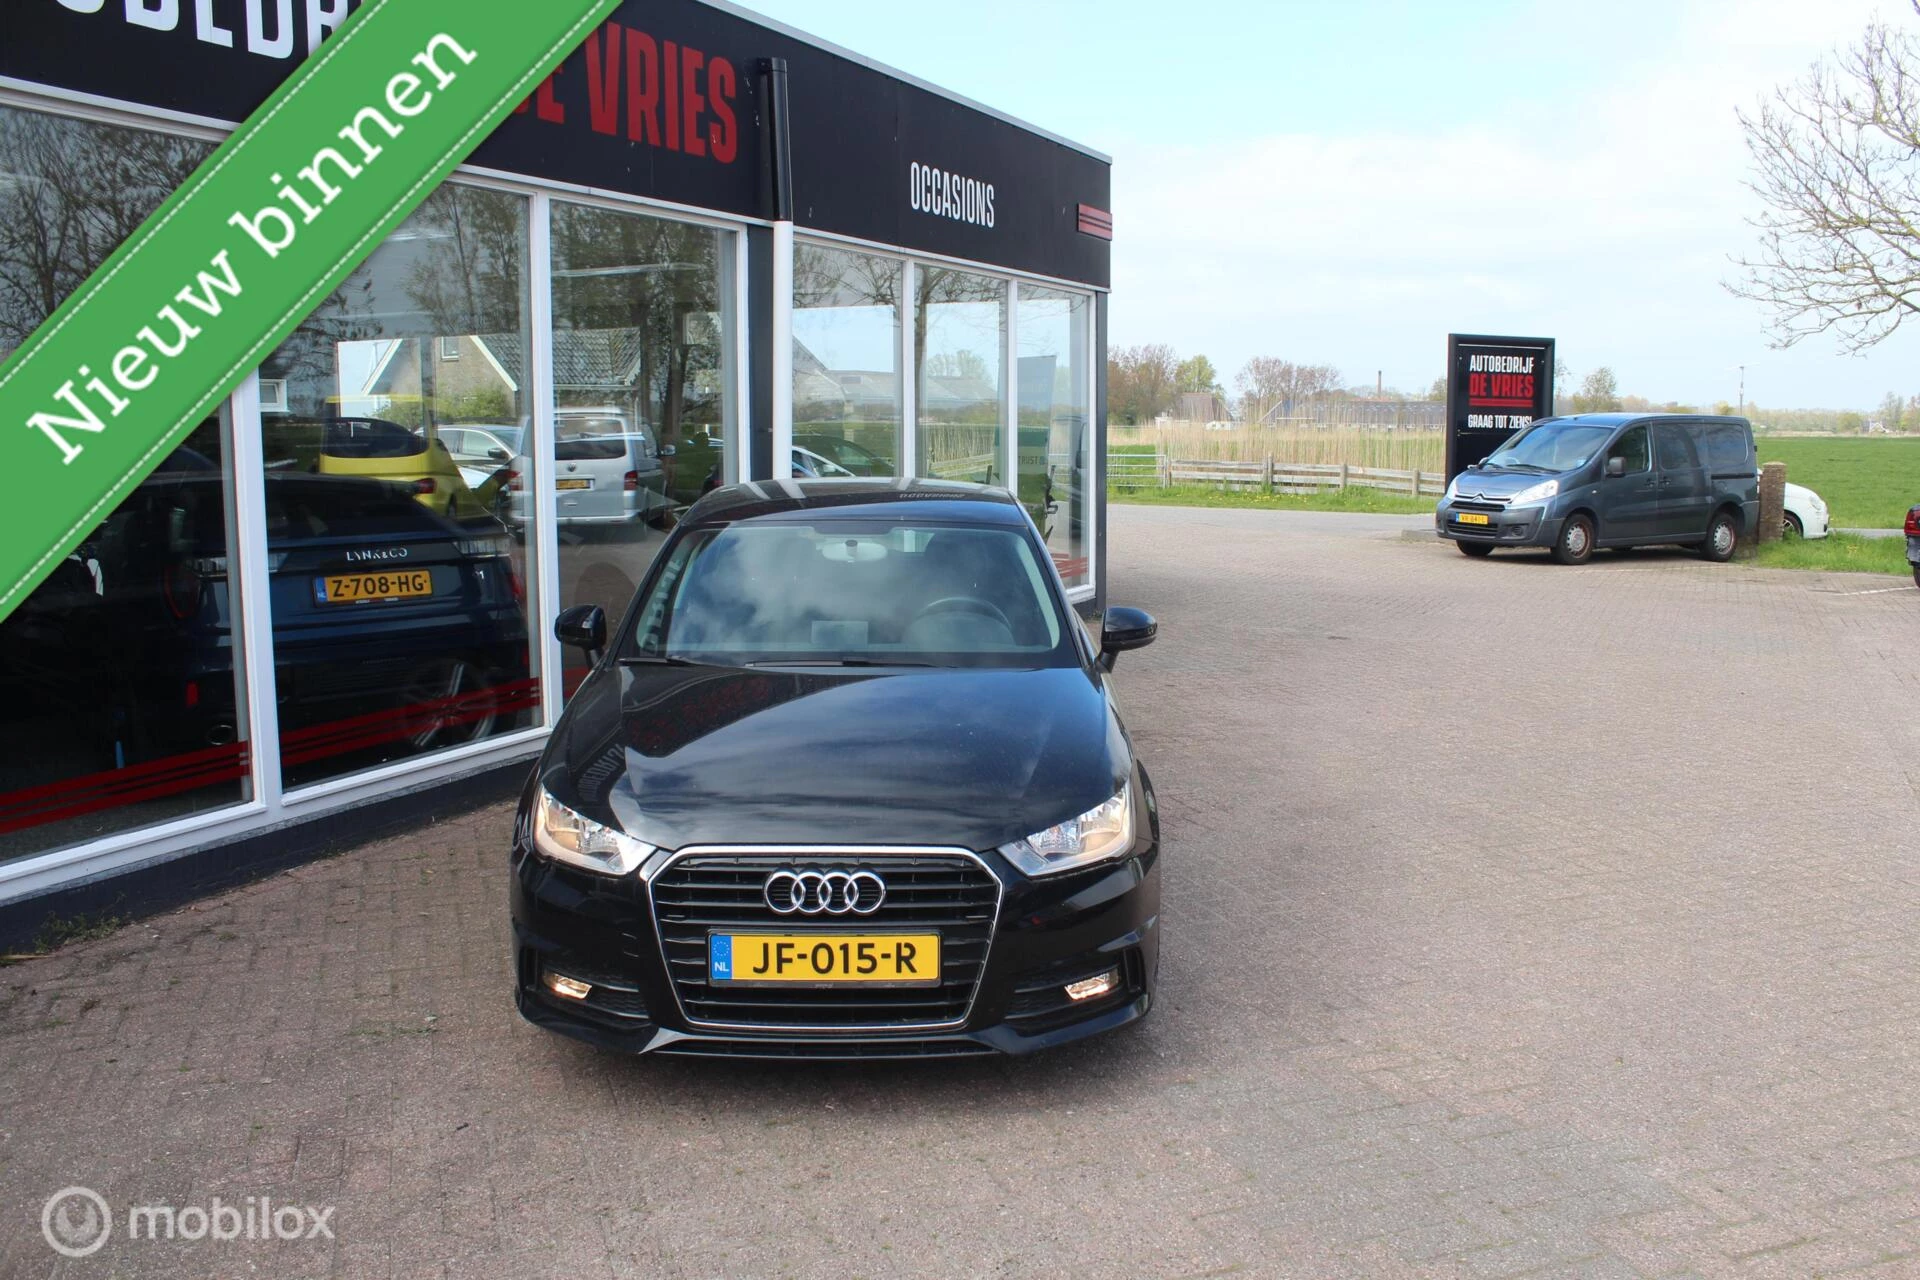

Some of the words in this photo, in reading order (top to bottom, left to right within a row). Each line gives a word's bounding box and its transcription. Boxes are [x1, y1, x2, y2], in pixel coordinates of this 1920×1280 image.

[585, 20, 738, 164] VRIES
[910, 161, 995, 228] OCCASIONS
[1469, 354, 1535, 374] AUTOBEDRIJF
[1469, 373, 1488, 396] DE
[1491, 374, 1534, 398] VRIES
[1467, 414, 1494, 428] GRAAG
[1494, 415, 1508, 428] TOT
[332, 574, 425, 598] Z-708-HG
[714, 961, 730, 973] NL
[752, 942, 918, 975] JF-015-R
